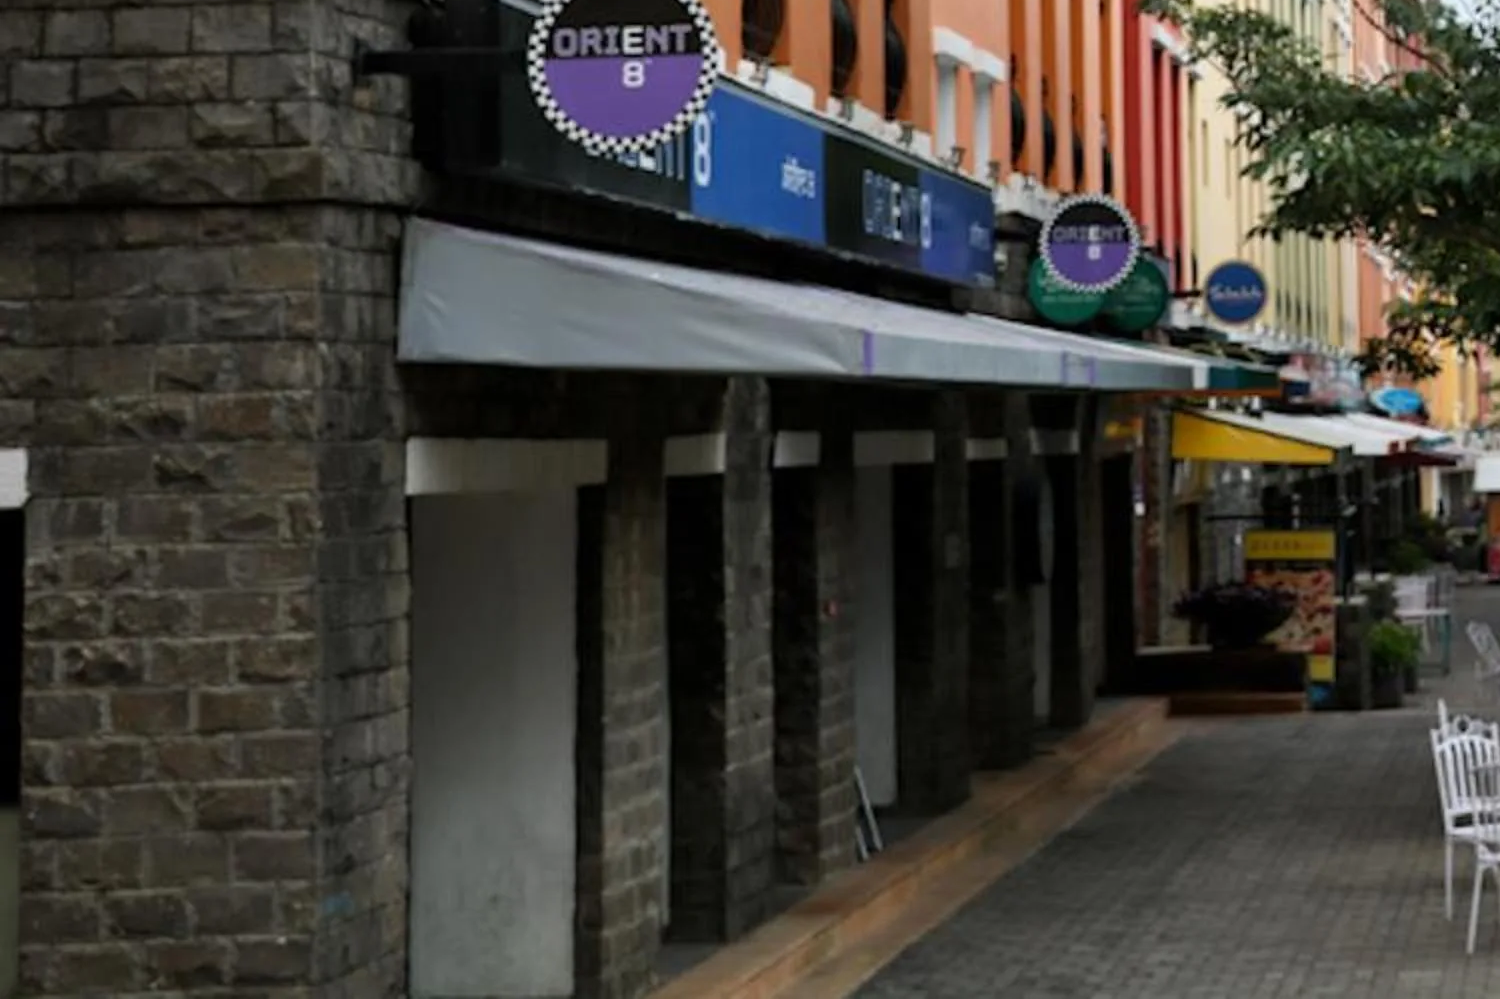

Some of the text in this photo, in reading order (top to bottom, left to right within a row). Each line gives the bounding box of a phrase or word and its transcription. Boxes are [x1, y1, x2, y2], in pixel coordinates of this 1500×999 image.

[552, 24, 693, 57] ORIENT
[622, 60, 645, 89] 8
[693, 112, 711, 188] 8
[1051, 224, 1125, 243] ORIENT
[1087, 244, 1101, 261] 8
